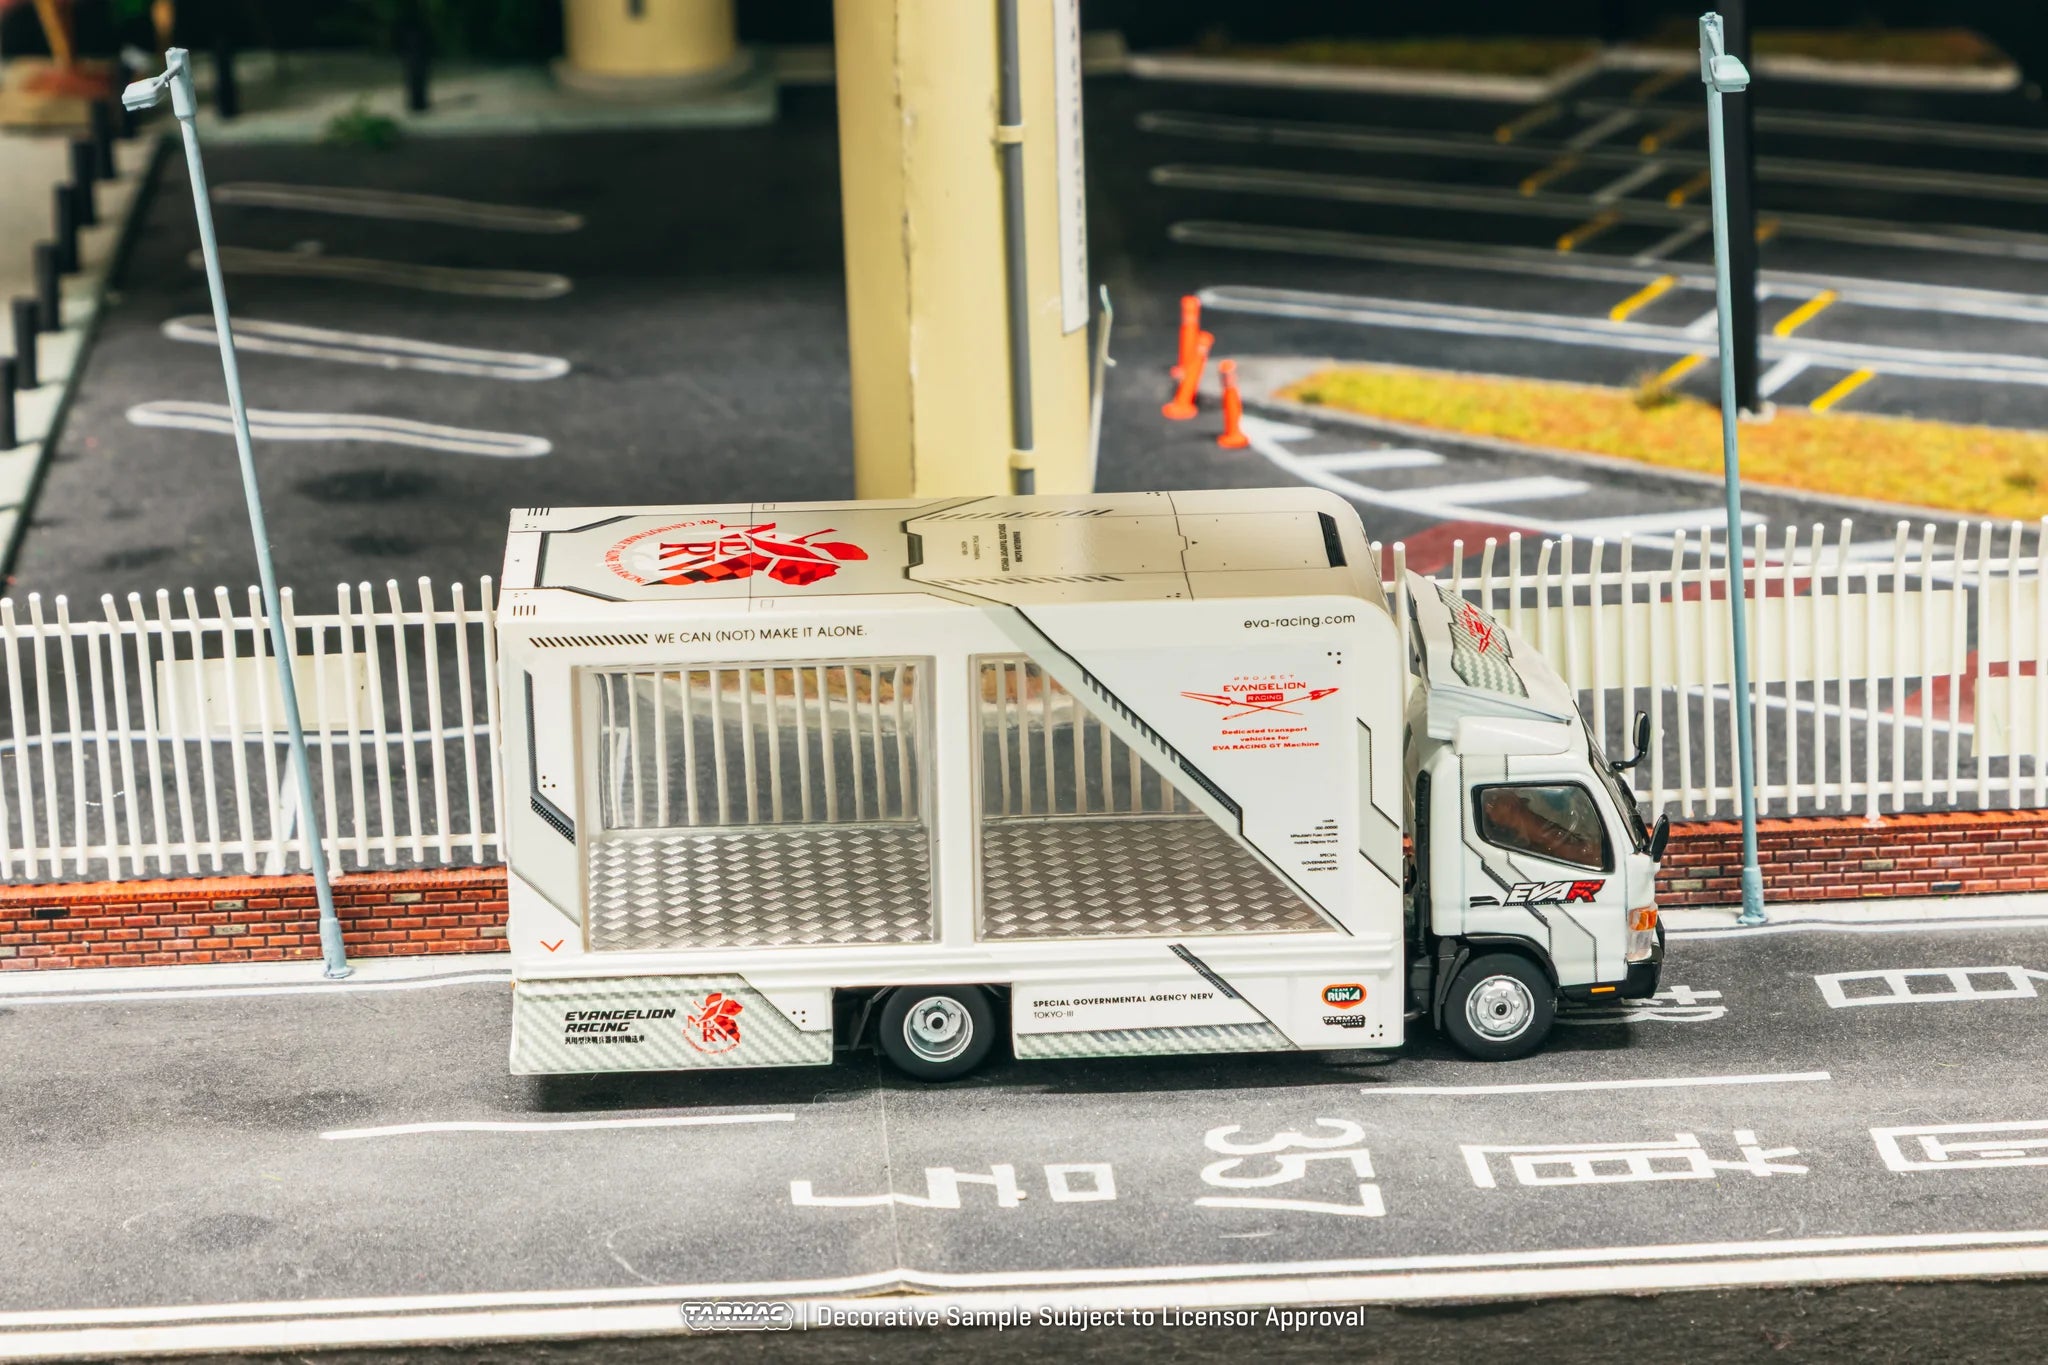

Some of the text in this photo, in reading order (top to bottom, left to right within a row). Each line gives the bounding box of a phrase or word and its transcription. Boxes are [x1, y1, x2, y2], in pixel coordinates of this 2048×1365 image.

[1244, 614, 1356, 628] eva-racing.com
[654, 625, 868, 644] WE CAN (NOT) MAKE IT ALONE.
[1222, 682, 1307, 693] EVANGELION
[1247, 694, 1283, 702] RACING
[1267, 727, 1308, 735] transport
[1073, 996, 1147, 1006] GOVERNMENTAL
[1150, 993, 1188, 1002] AGENCY
[1190, 992, 1214, 1000] NERV
[564, 1009, 676, 1021] EVANGELION
[564, 1022, 630, 1033] RACING
